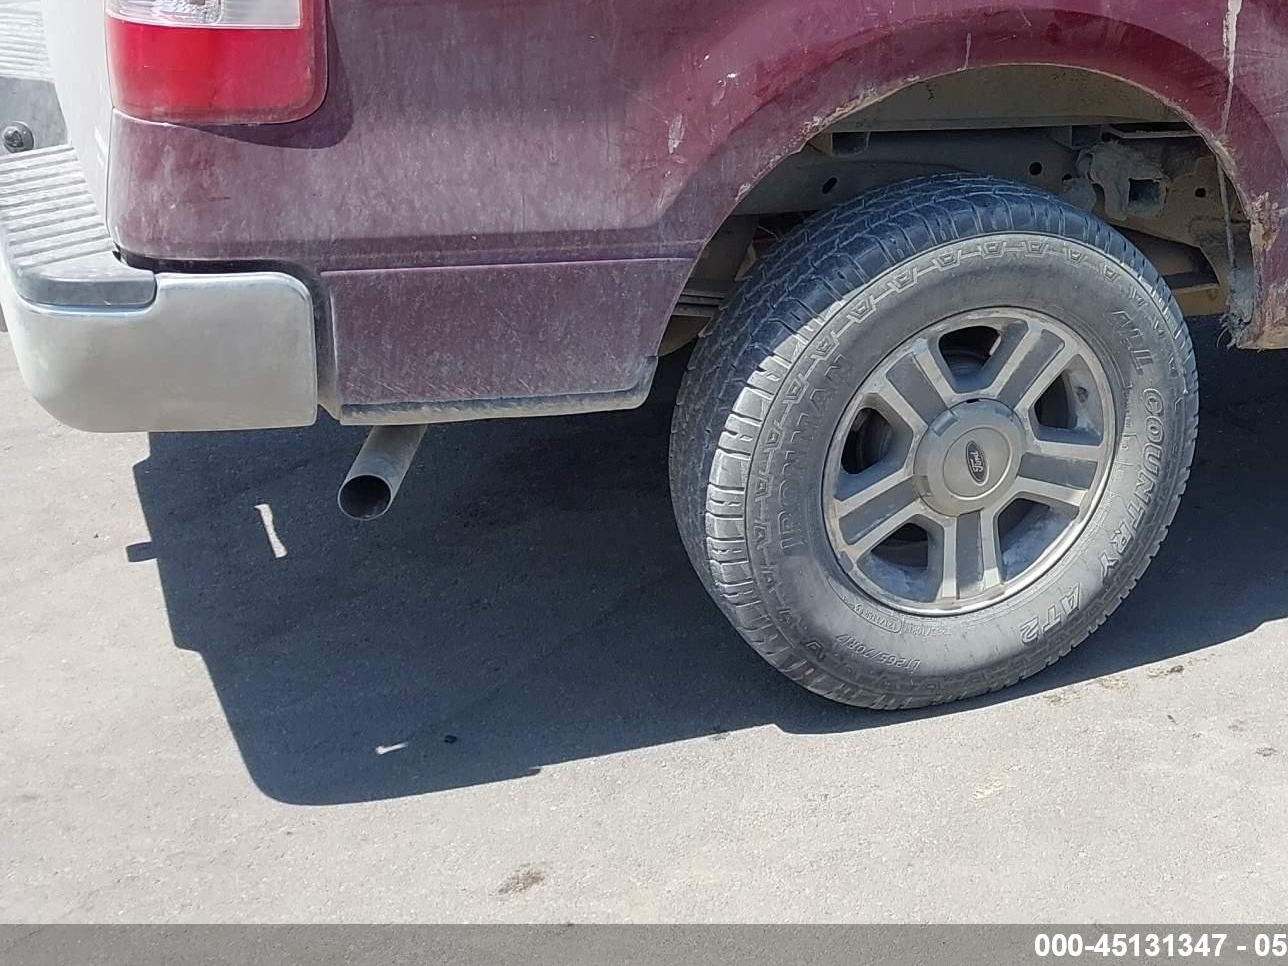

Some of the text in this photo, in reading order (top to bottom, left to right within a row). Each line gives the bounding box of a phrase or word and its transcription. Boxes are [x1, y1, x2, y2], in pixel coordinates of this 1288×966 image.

[777, 352, 849, 555] IRONMAN
[1100, 388, 1165, 584] COUNTRY
[1020, 583, 1081, 643] AT2
